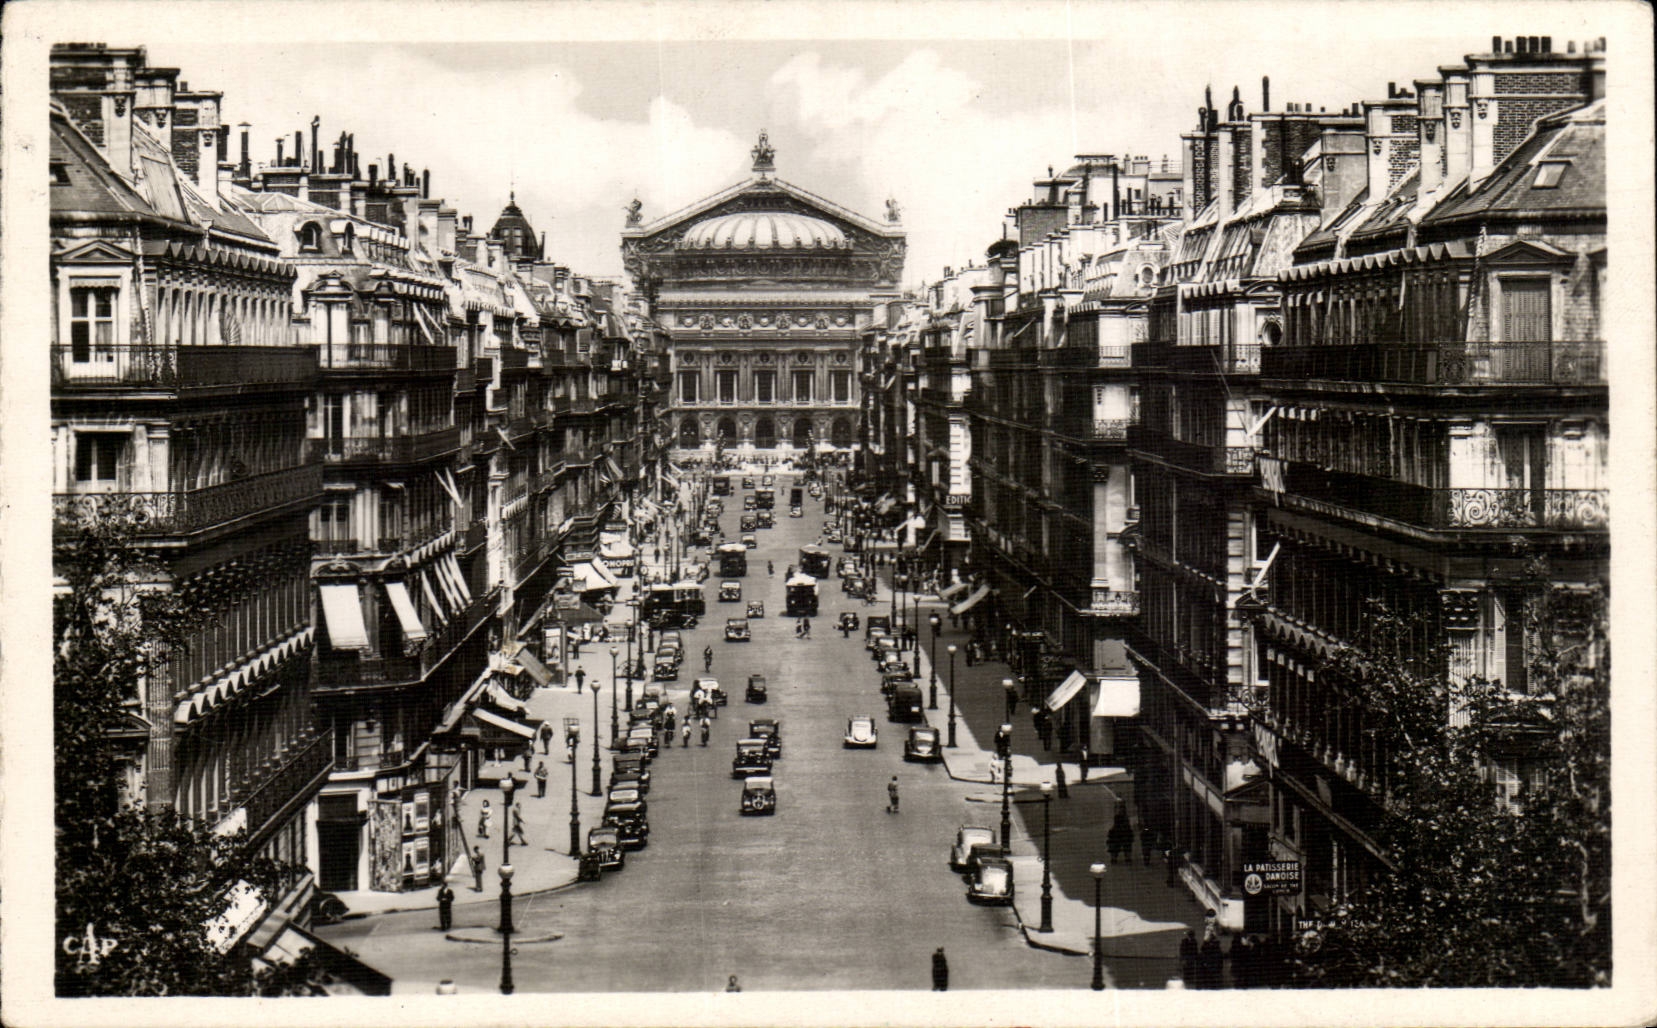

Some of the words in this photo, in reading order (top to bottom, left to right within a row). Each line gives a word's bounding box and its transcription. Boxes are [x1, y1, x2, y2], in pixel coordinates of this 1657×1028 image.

[1244, 864, 1253, 872] LA
[1256, 863, 1299, 872] PATISSERIE
[1265, 872, 1299, 880] DANOISE
